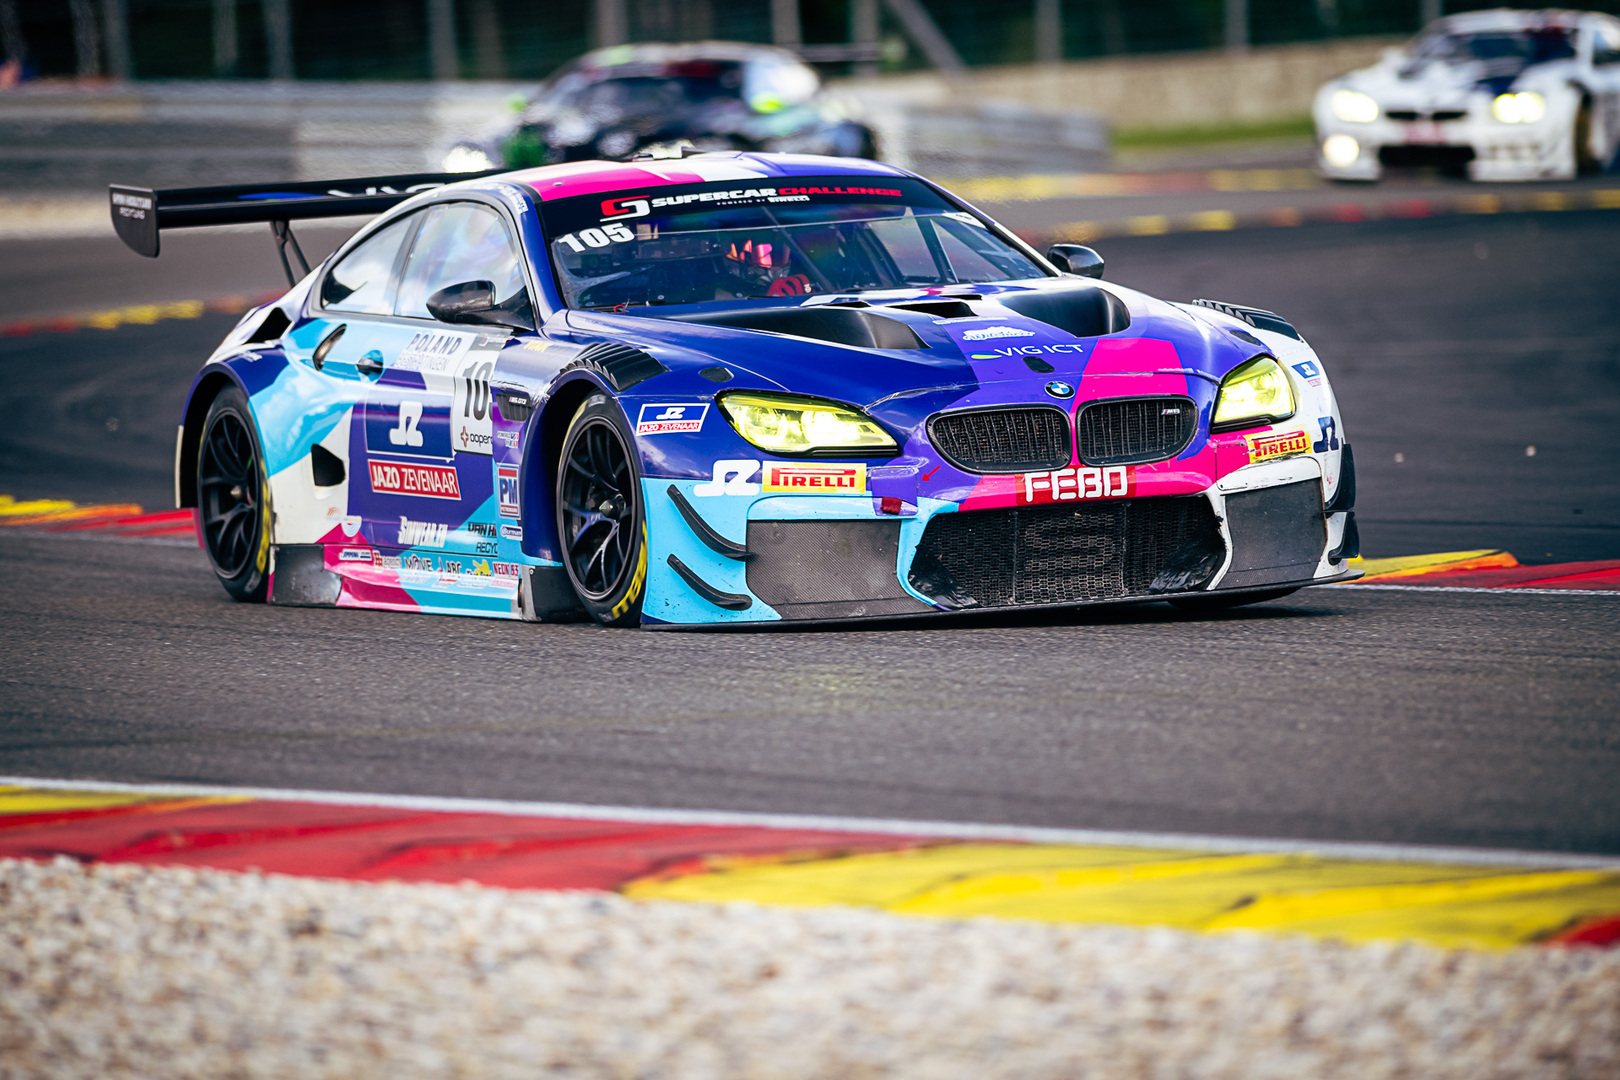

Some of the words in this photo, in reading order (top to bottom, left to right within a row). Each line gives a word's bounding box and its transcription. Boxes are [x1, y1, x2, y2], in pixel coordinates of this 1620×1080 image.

[651, 188, 777, 208] SUPERCAR
[778, 186, 903, 197] CHALLENGE
[557, 222, 635, 253] 105
[406, 333, 463, 355] POLAND
[994, 345, 1043, 357] VIG
[1043, 344, 1084, 354] ICT
[462, 361, 493, 420] 10
[640, 424, 660, 433] JAZO
[660, 422, 699, 432] ZEVENAAR
[1251, 430, 1307, 457] PIRELLI
[373, 464, 401, 489] JAZO
[401, 467, 458, 495] ZEVENAAR
[770, 467, 857, 488] PIRELLI
[1024, 466, 1128, 503] FEBO
[499, 478, 518, 505] PM
